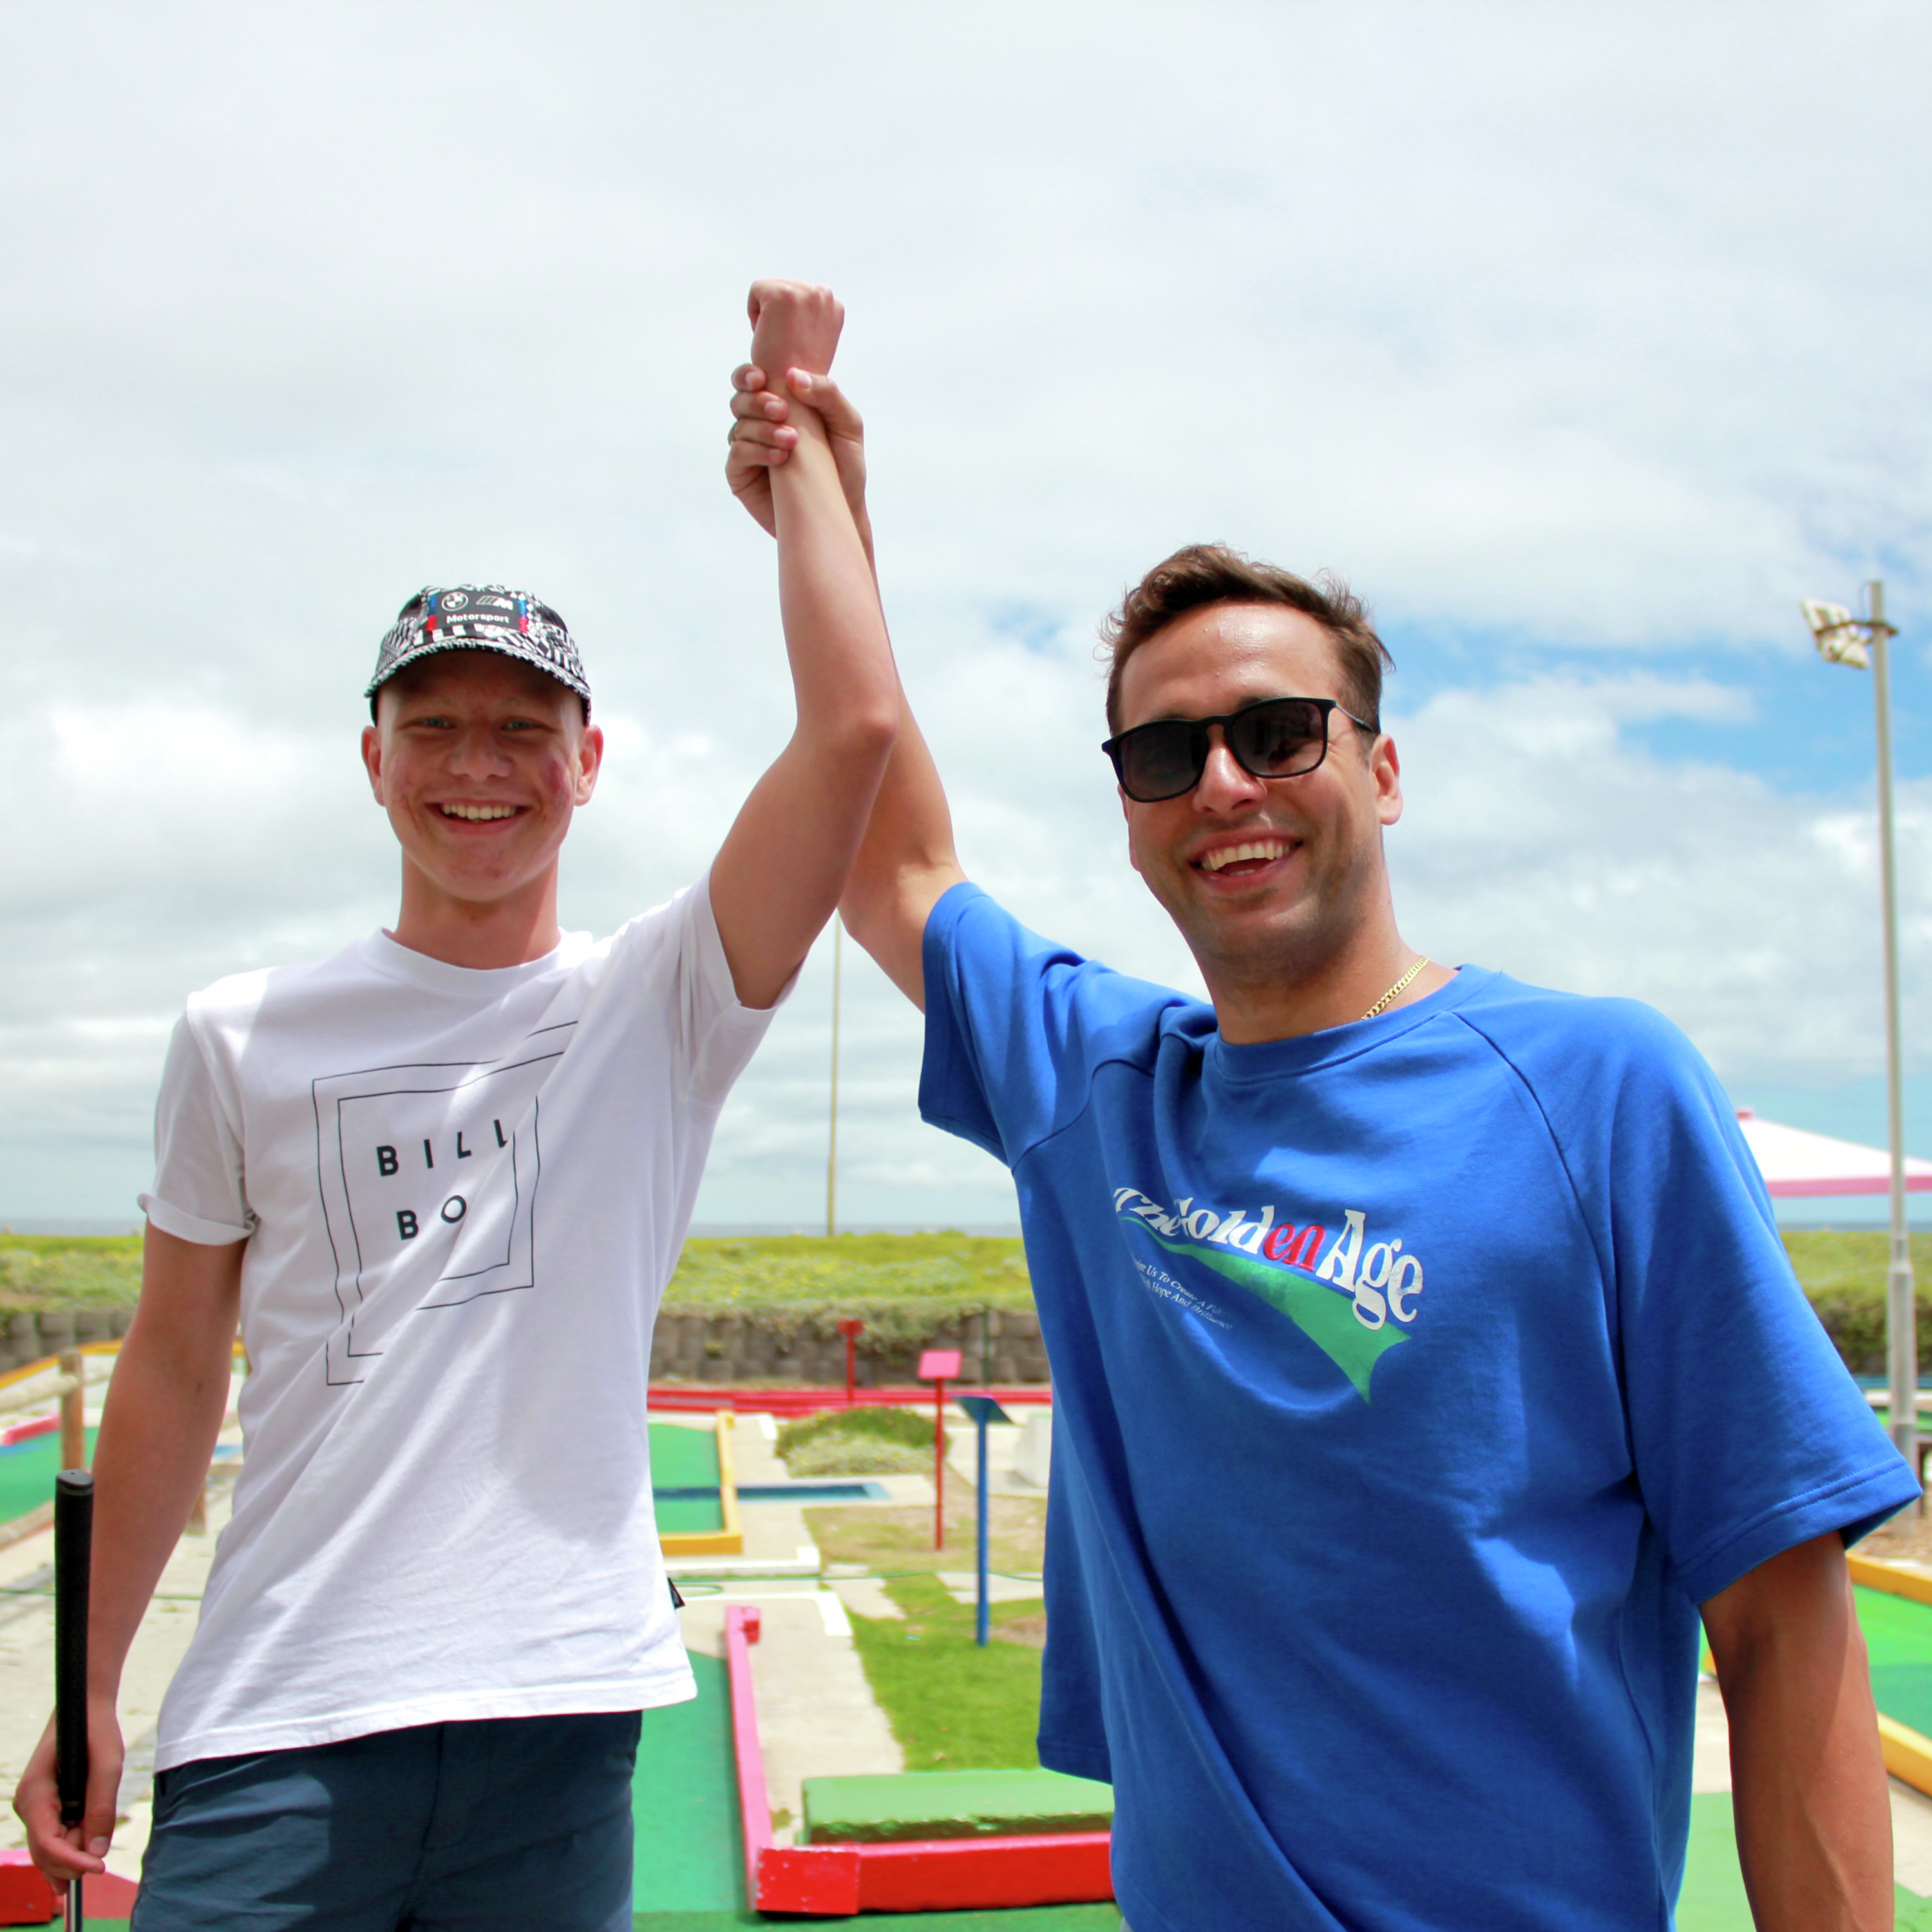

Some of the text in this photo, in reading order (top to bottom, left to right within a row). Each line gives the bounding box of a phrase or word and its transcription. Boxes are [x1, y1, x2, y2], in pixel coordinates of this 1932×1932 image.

[446, 614, 510, 624] Motorsport
[1113, 1188, 1180, 1236] The
[1315, 1209, 1423, 1331] Age
[1146, 1265, 1158, 1278] Us
[1159, 1271, 1170, 1283] To
[1151, 1282, 1171, 1298] Hope
[1171, 1293, 1193, 1307] And
